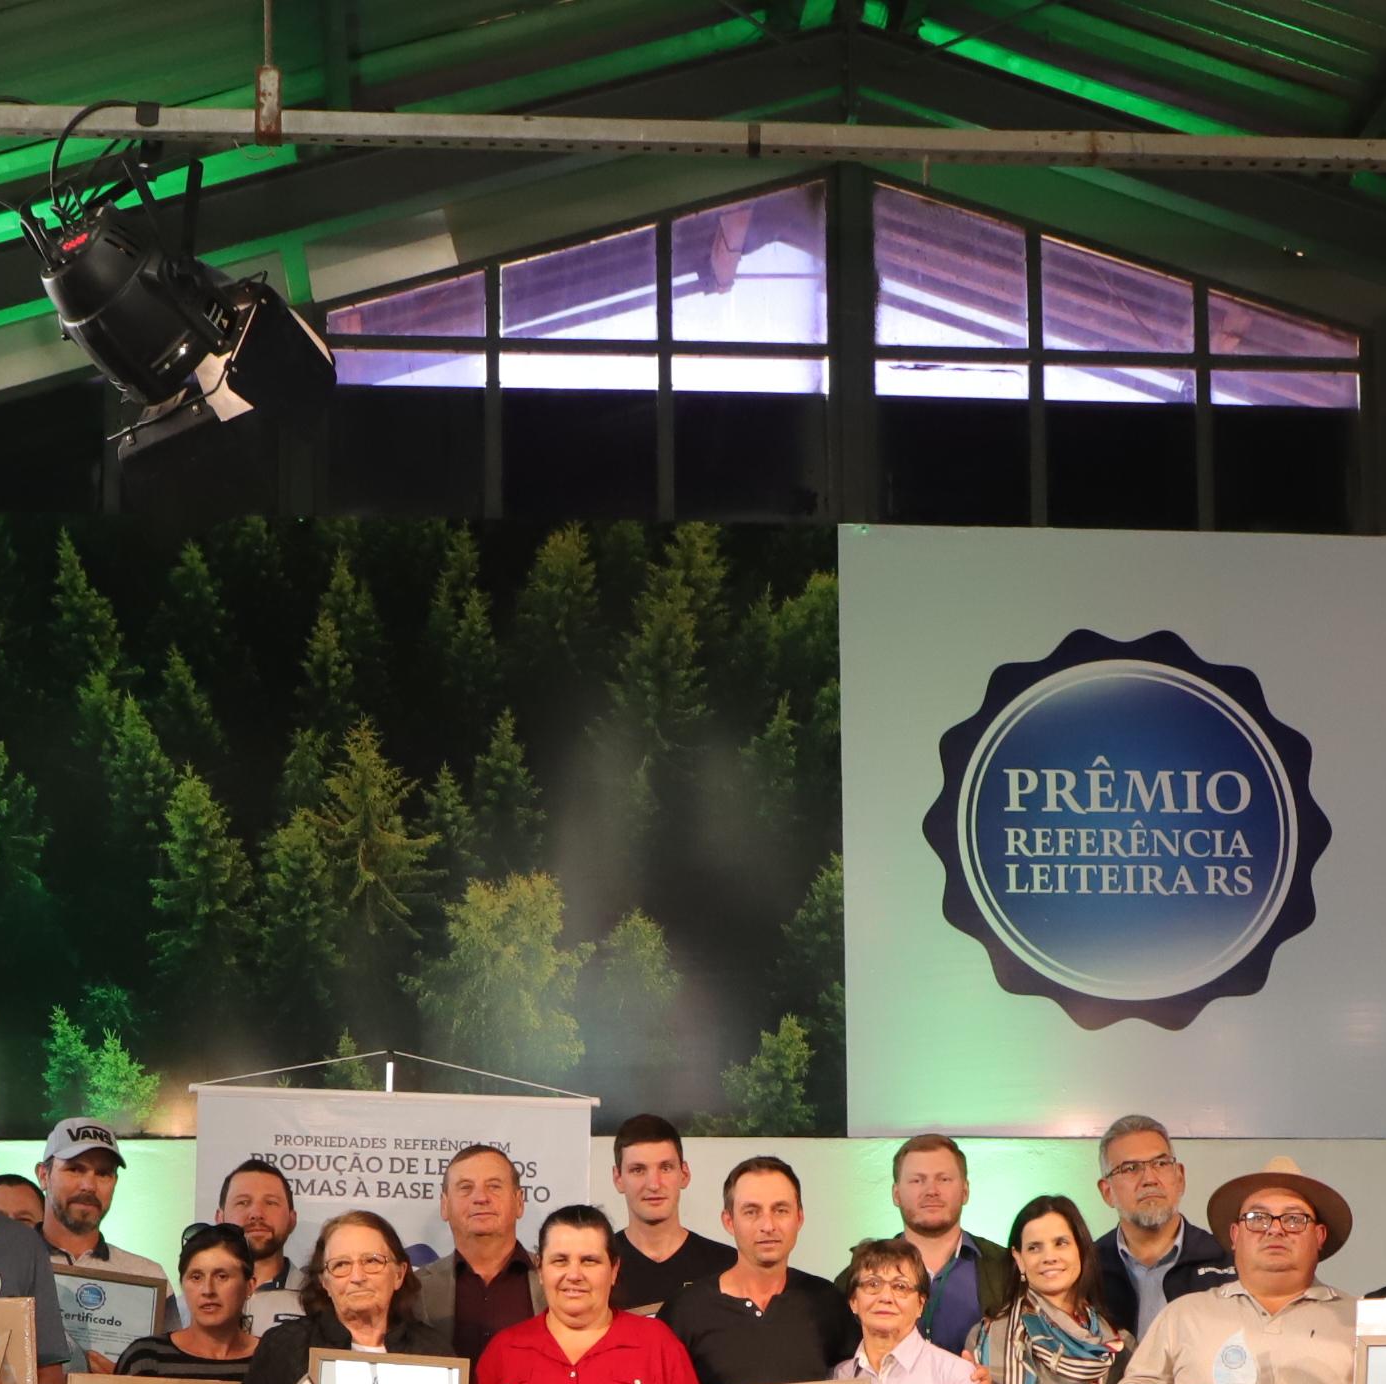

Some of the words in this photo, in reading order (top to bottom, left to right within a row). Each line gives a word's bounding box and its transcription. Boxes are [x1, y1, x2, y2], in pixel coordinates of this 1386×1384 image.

[1003, 755, 1252, 815] PRÊMIO
[1004, 819, 1254, 858] REFERÊNCIA
[1005, 863, 1198, 896] LEITEIRA
[1204, 865, 1254, 897] RS
[66, 1126, 114, 1146] VANS
[274, 1134, 387, 1149] PROPRIEDADES
[388, 1157, 419, 1175] DE
[353, 1178, 372, 1197] À
[376, 1182, 434, 1200] BASE
